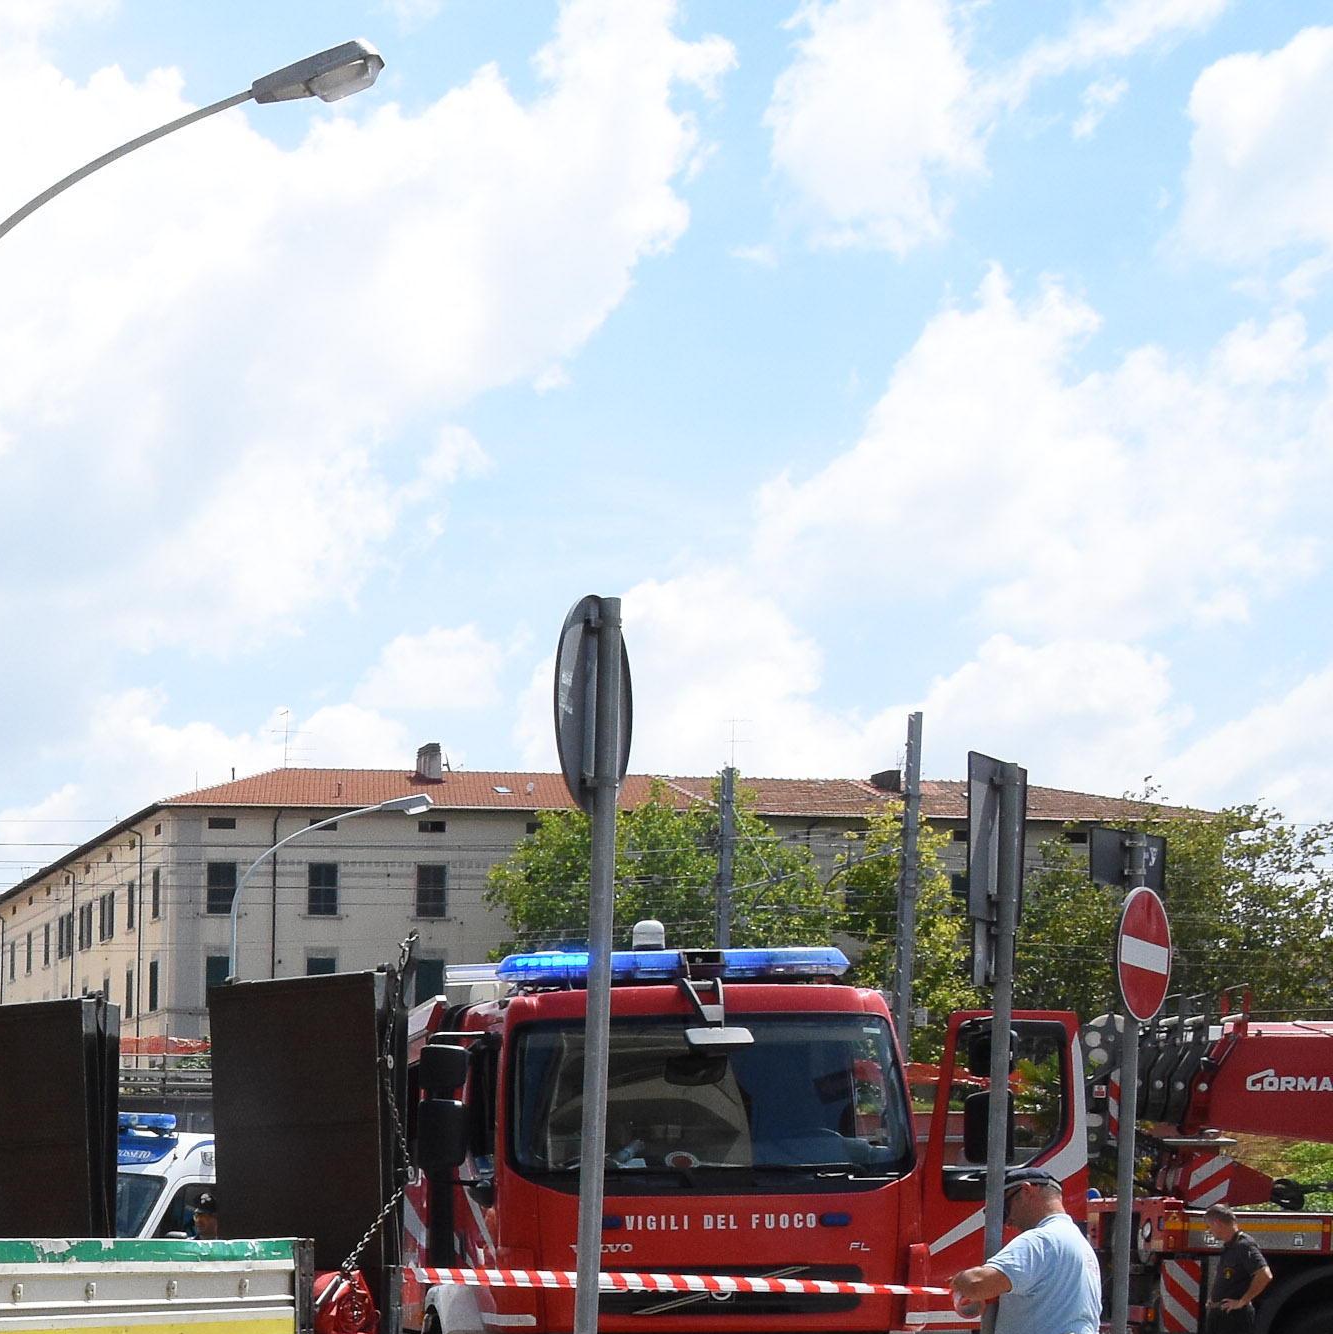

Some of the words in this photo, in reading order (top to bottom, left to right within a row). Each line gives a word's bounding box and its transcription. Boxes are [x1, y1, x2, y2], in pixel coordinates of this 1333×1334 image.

[625, 1214, 689, 1231] VIGILI
[703, 1214, 738, 1230] DEL
[751, 1212, 817, 1229] FUOCO
[848, 1241, 871, 1251] FL
